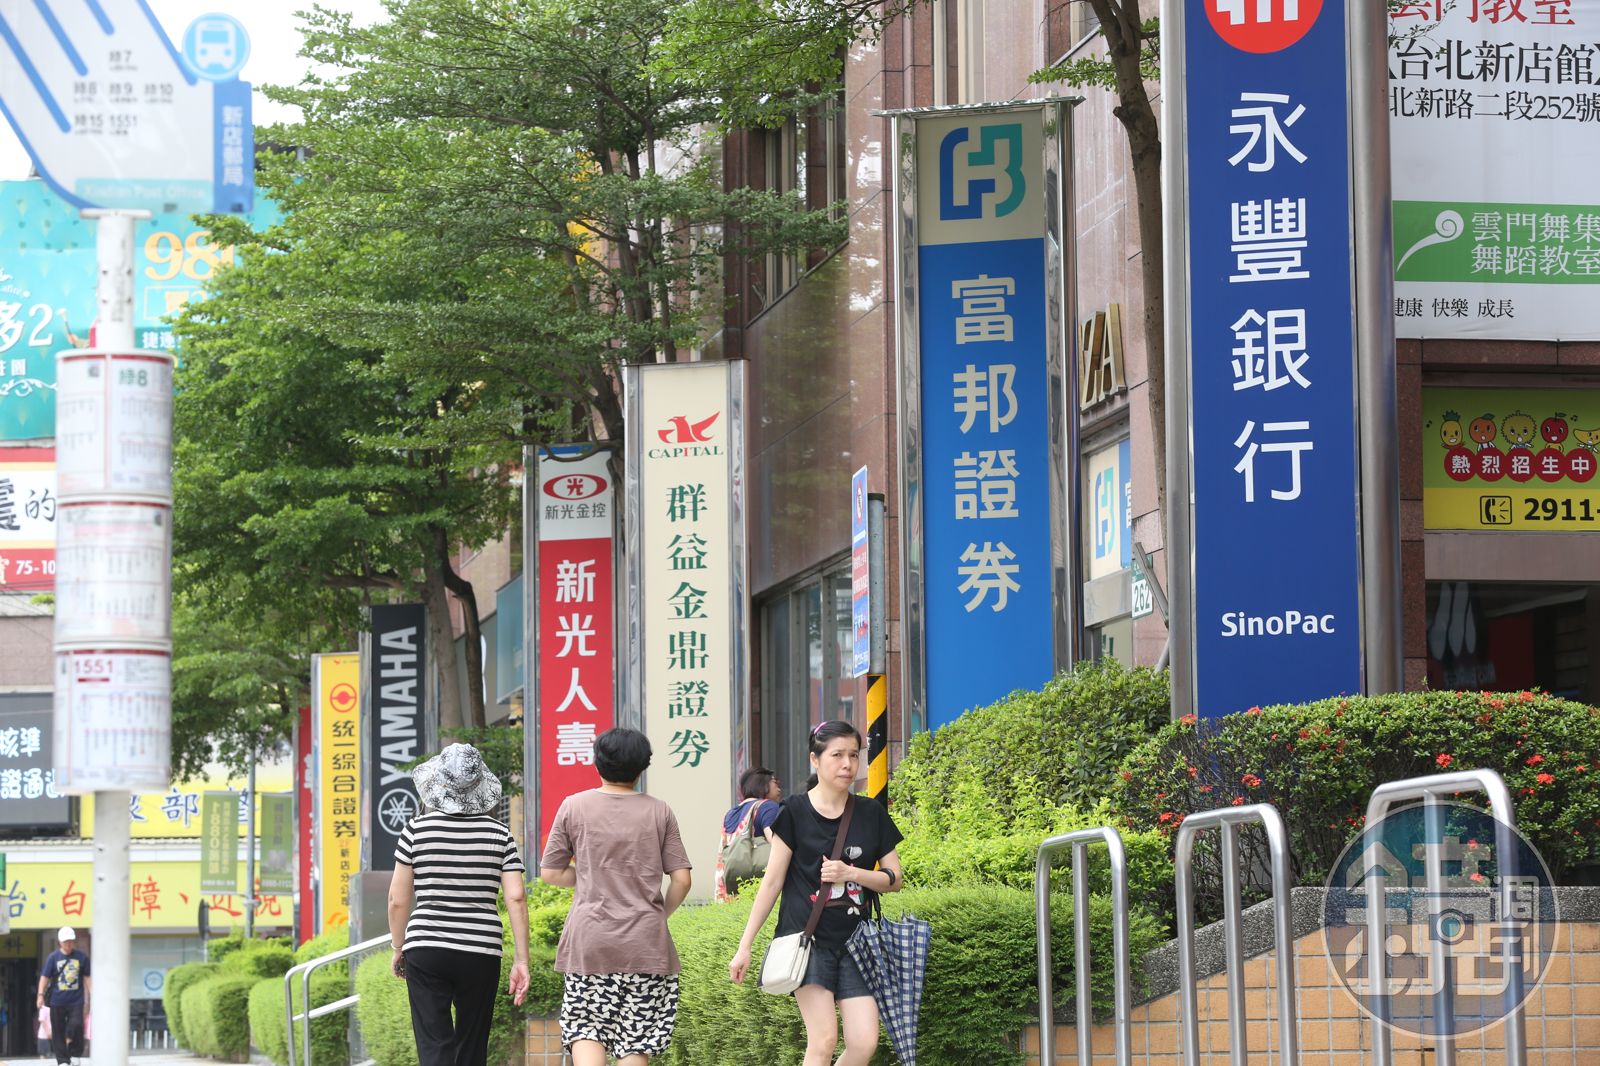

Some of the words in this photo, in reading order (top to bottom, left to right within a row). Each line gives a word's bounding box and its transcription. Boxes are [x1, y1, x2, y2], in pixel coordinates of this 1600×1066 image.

[1471, 211, 1600, 243] 雲門舞集
[1470, 243, 1600, 276] 舞蹈教室
[1227, 92, 1314, 502] 永豐銀行
[1431, 298, 1469, 318] 快樂
[1477, 298, 1514, 318] 成長
[1079, 303, 1128, 412] ZA
[648, 446, 724, 459] CAPITAL
[952, 274, 1021, 613] 富邦證券
[1451, 455, 1590, 476] 熱烈招生中
[545, 503, 606, 520] 新光金控
[1134, 583, 1151, 613] 262
[666, 484, 710, 768] 群益金鼎證券
[1221, 611, 1336, 637] SinoPac
[75, 659, 114, 674] 1551
[555, 559, 597, 766] 新光人壽
[380, 626, 417, 786] YAMAHA
[332, 720, 357, 838] 統一綜合證券
